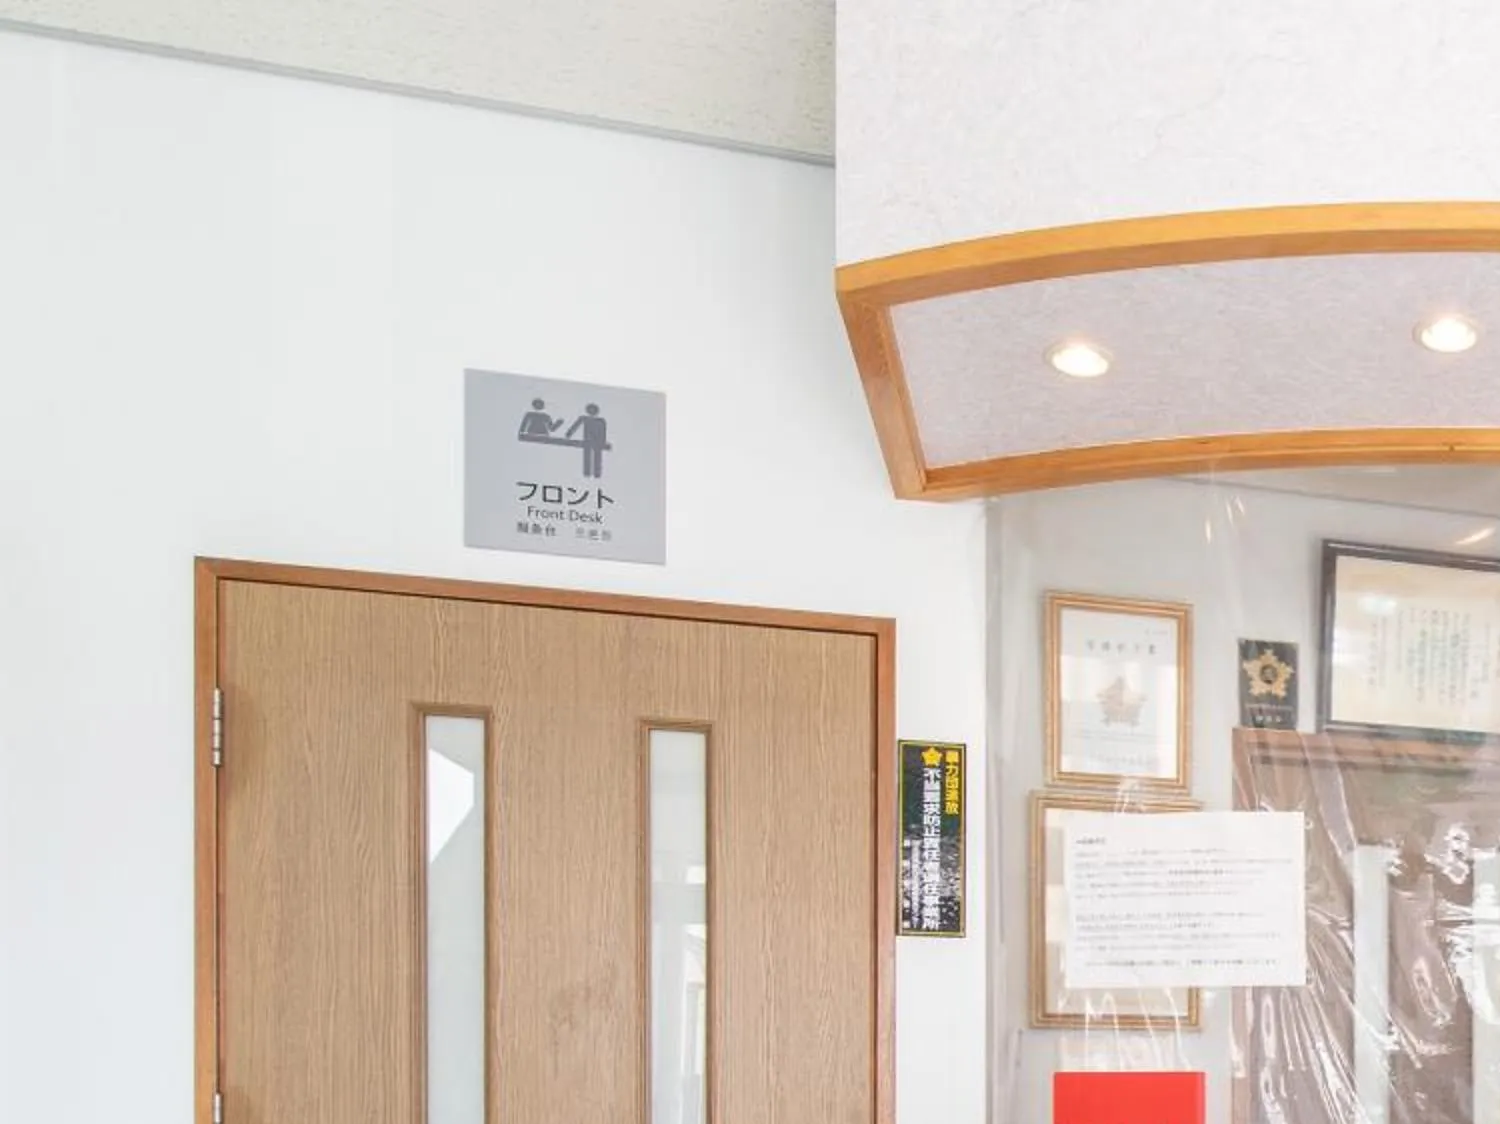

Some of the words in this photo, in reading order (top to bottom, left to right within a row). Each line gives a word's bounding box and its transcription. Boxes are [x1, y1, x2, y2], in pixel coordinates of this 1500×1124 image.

[515, 481, 614, 509] フロント
[526, 505, 565, 522] Front
[569, 508, 604, 525] Desk
